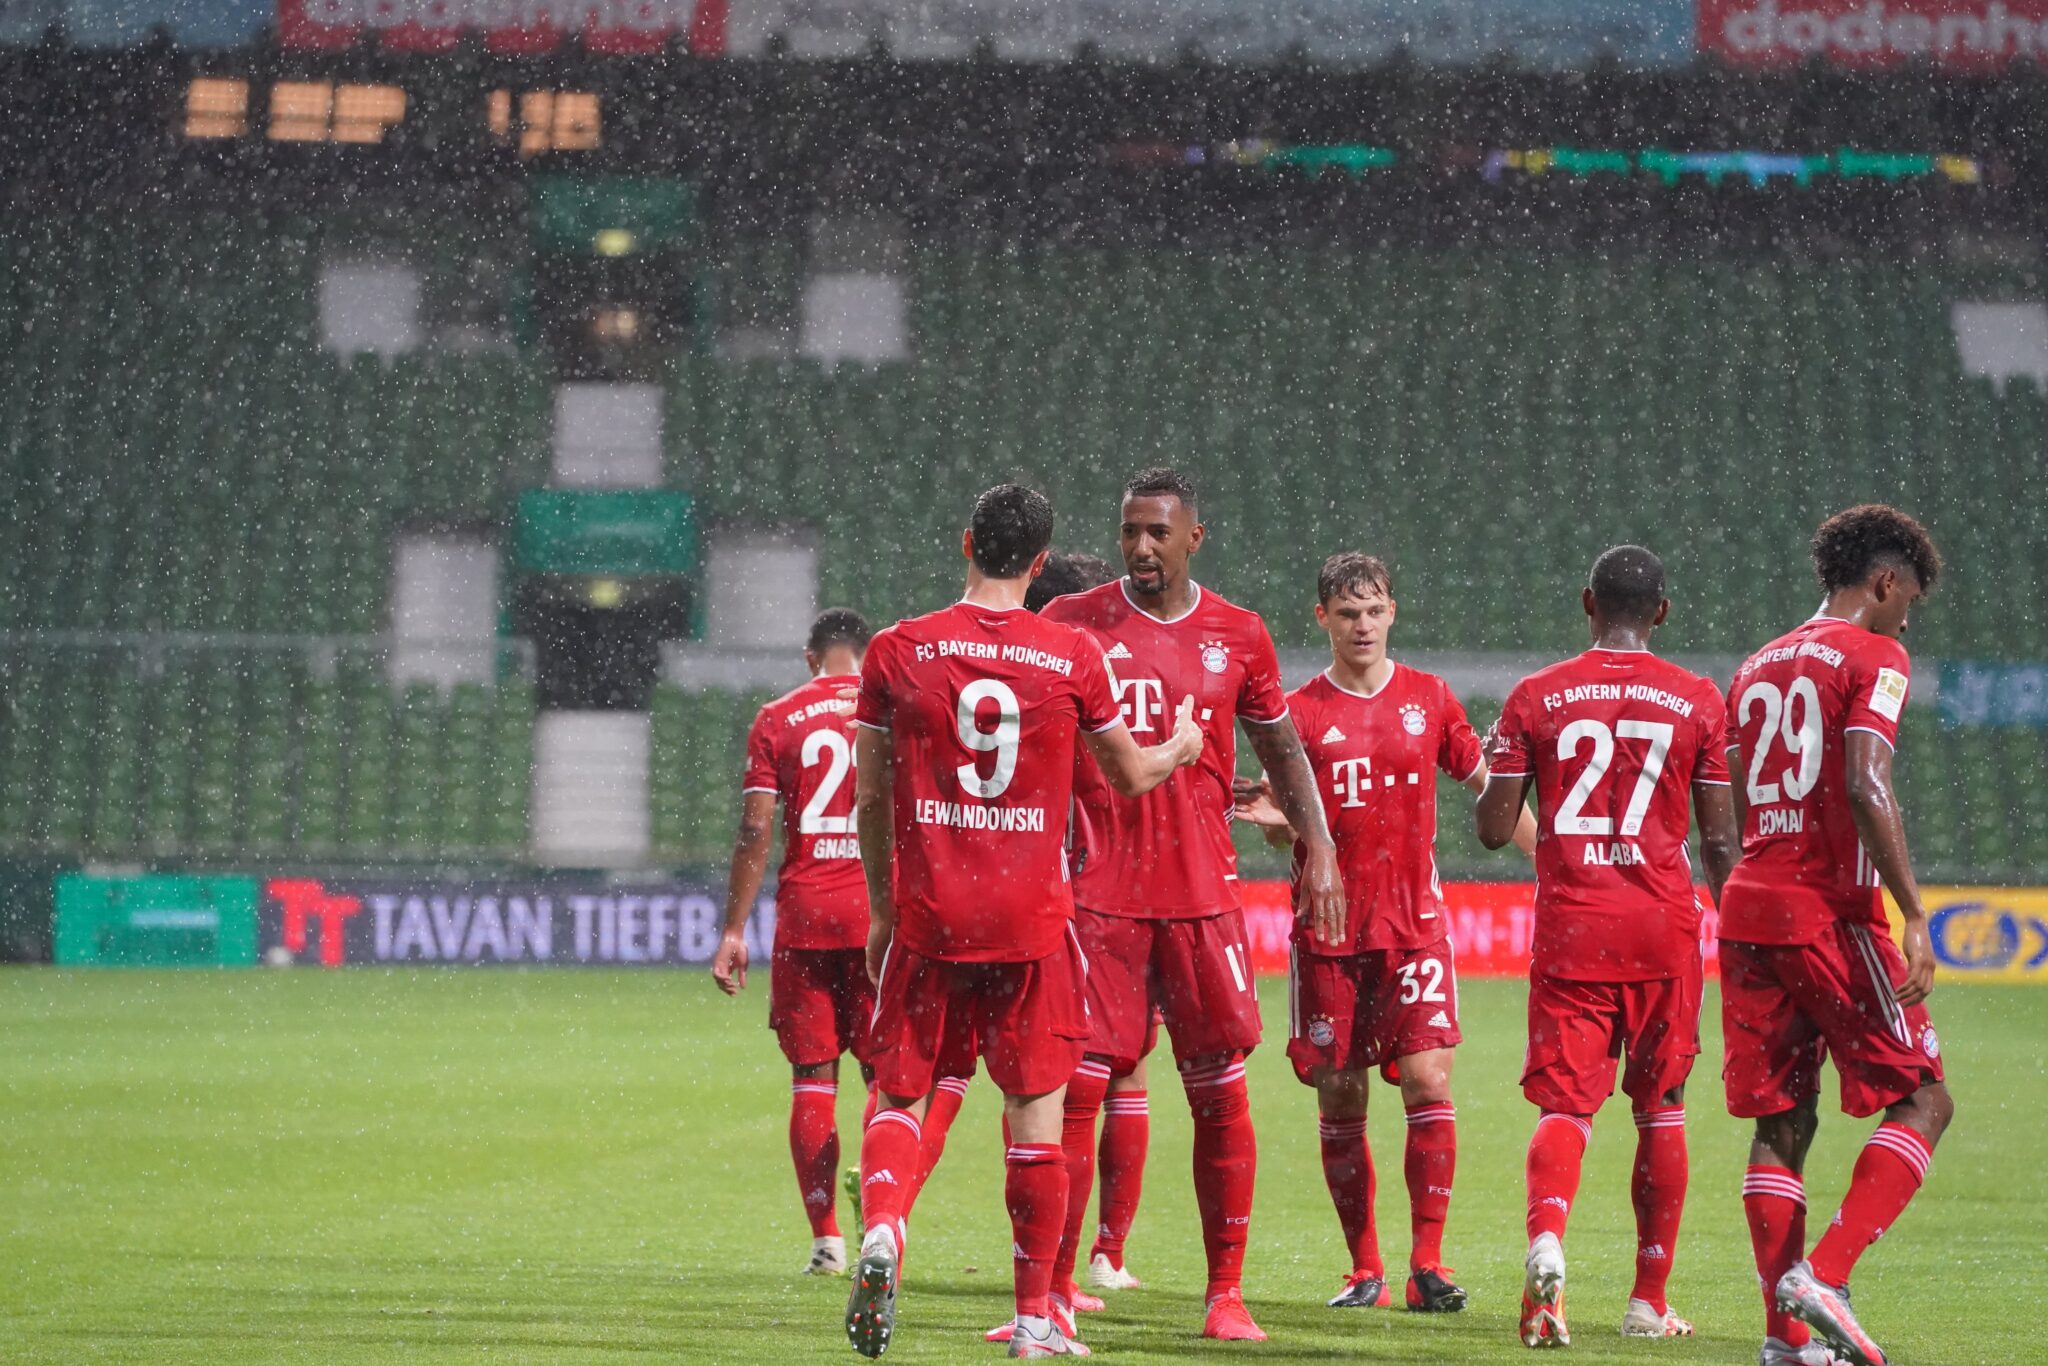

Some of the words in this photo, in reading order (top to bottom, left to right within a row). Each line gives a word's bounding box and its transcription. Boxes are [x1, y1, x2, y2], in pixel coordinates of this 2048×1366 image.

[1723, 0, 2048, 51] dodenh
[915, 643, 935, 662] FC
[938, 640, 998, 659] BAYERN
[1002, 644, 1073, 677] MÜNCHEN
[787, 710, 806, 727] FC
[1543, 693, 1562, 712] FC
[1564, 684, 1621, 704] BAYERN
[957, 678, 1021, 798] 9
[1738, 676, 1824, 806] 29
[800, 729, 858, 833] 2
[1554, 719, 1674, 837] 27
[916, 799, 1044, 832] LEWANDOWSKI
[1583, 842, 1646, 866] ALABA
[371, 895, 551, 961] TAVAN
[1397, 958, 1446, 1005] 32
